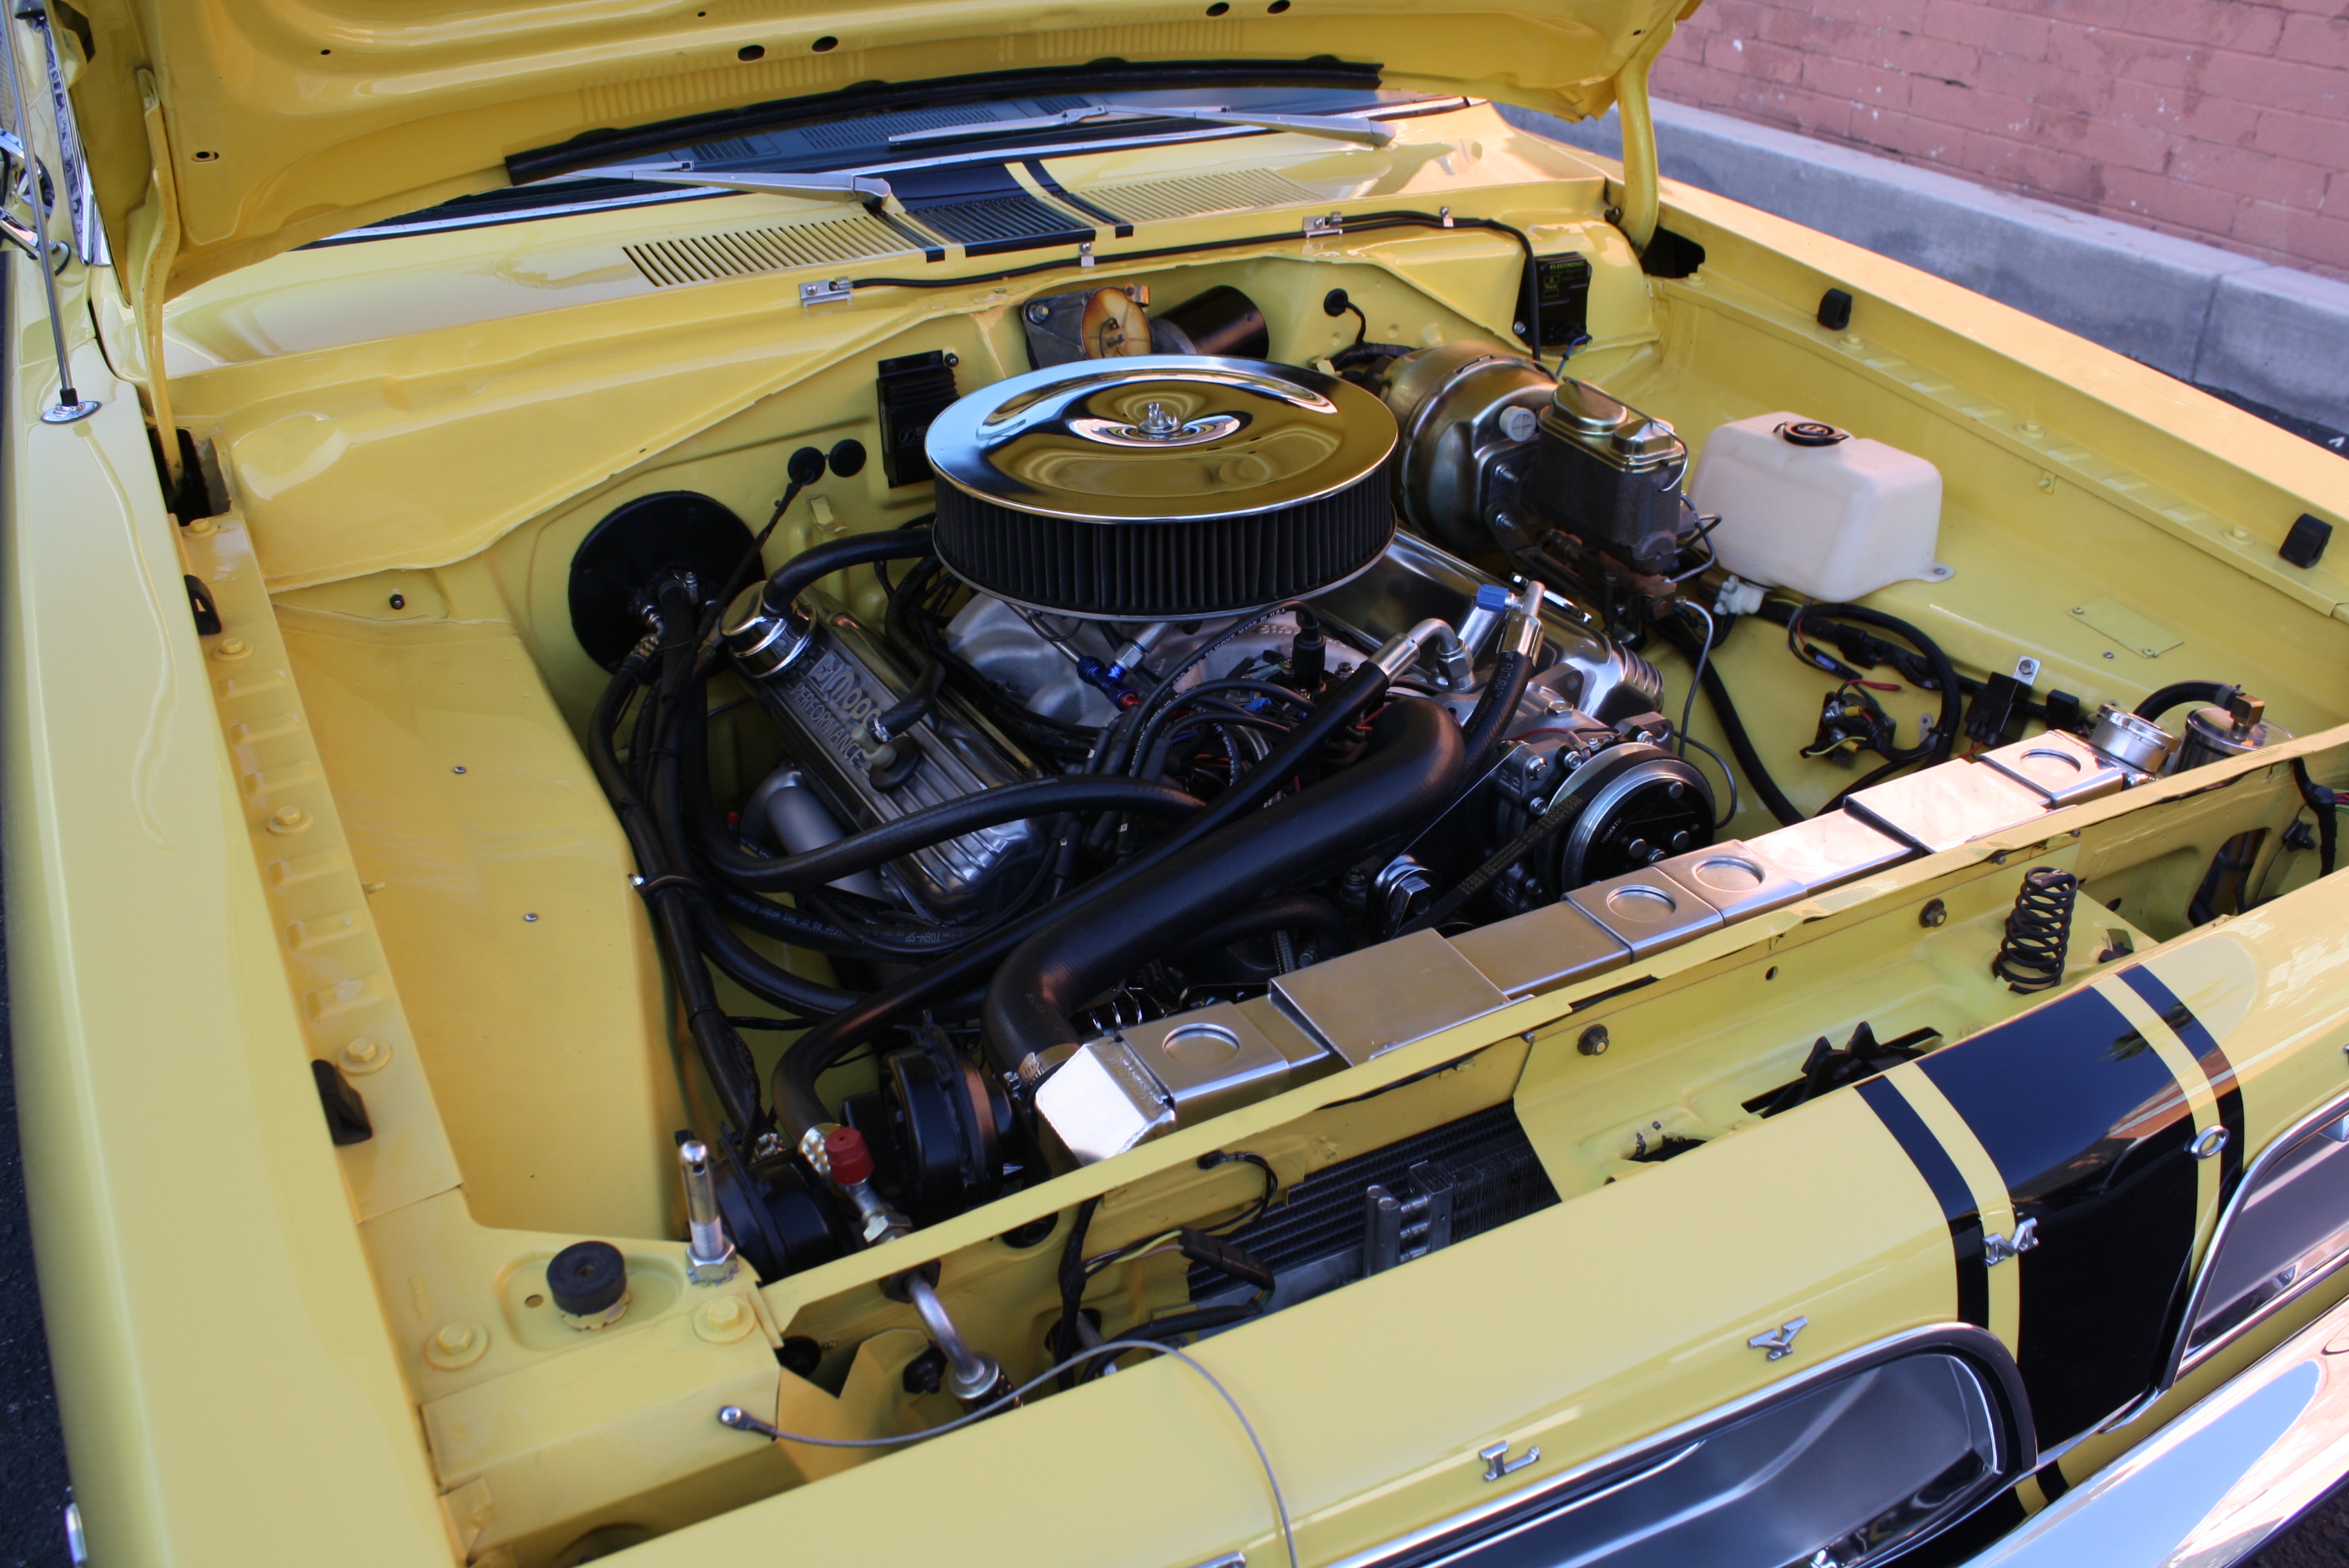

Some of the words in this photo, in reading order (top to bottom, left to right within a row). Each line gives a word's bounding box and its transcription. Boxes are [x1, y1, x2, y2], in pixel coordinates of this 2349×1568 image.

[1238, 620, 1258, 635] MADE
[793, 682, 868, 766] PERFORMANCE
[1748, 1315, 1808, 1363] Y
[1478, 1440, 1541, 1483] L
